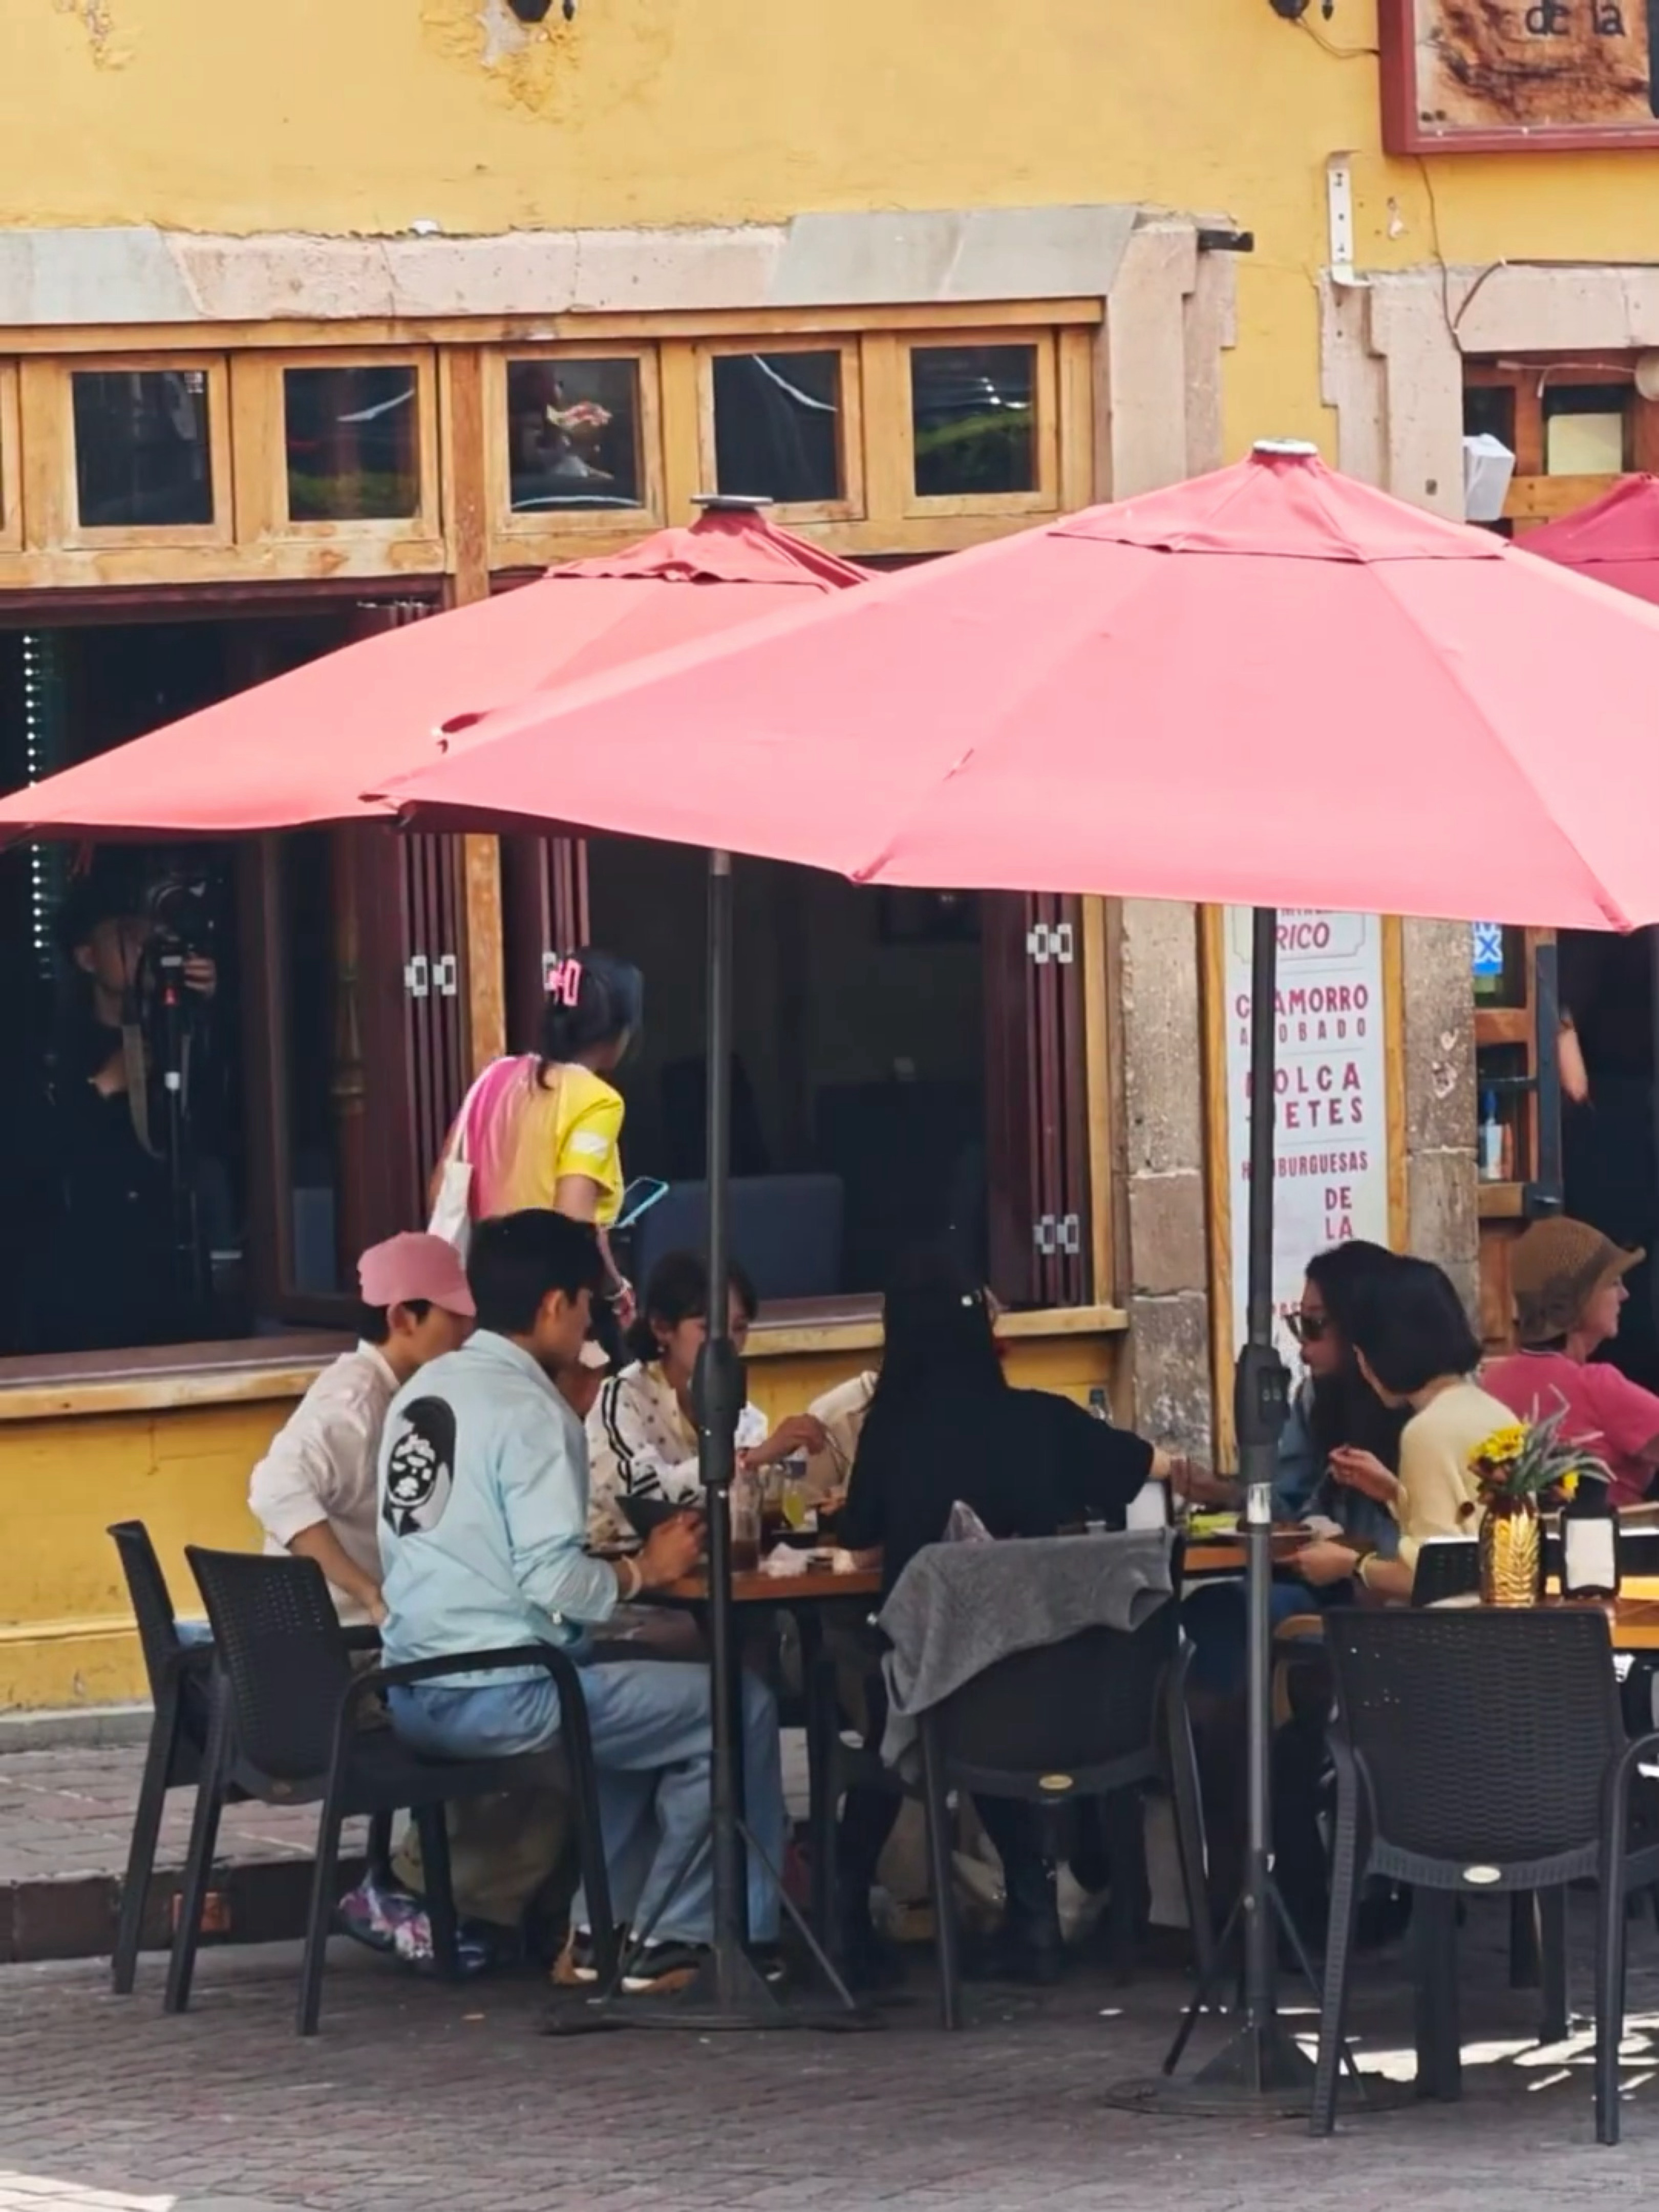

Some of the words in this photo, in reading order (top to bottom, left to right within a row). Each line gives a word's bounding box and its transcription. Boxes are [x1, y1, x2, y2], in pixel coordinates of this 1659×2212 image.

[1526, 0, 1570, 35] de
[1591, 0, 1625, 36] la
[1274, 921, 1330, 950] RICO
[1236, 984, 1369, 1019] CAMORRO
[1240, 1017, 1366, 1046] AOBADO
[1245, 1061, 1361, 1099] OLCA
[1245, 1097, 1363, 1129] ETES
[1241, 1150, 1368, 1180] HBURGUESAS
[1325, 1186, 1352, 1210] DE
[1325, 1215, 1353, 1240] LA
